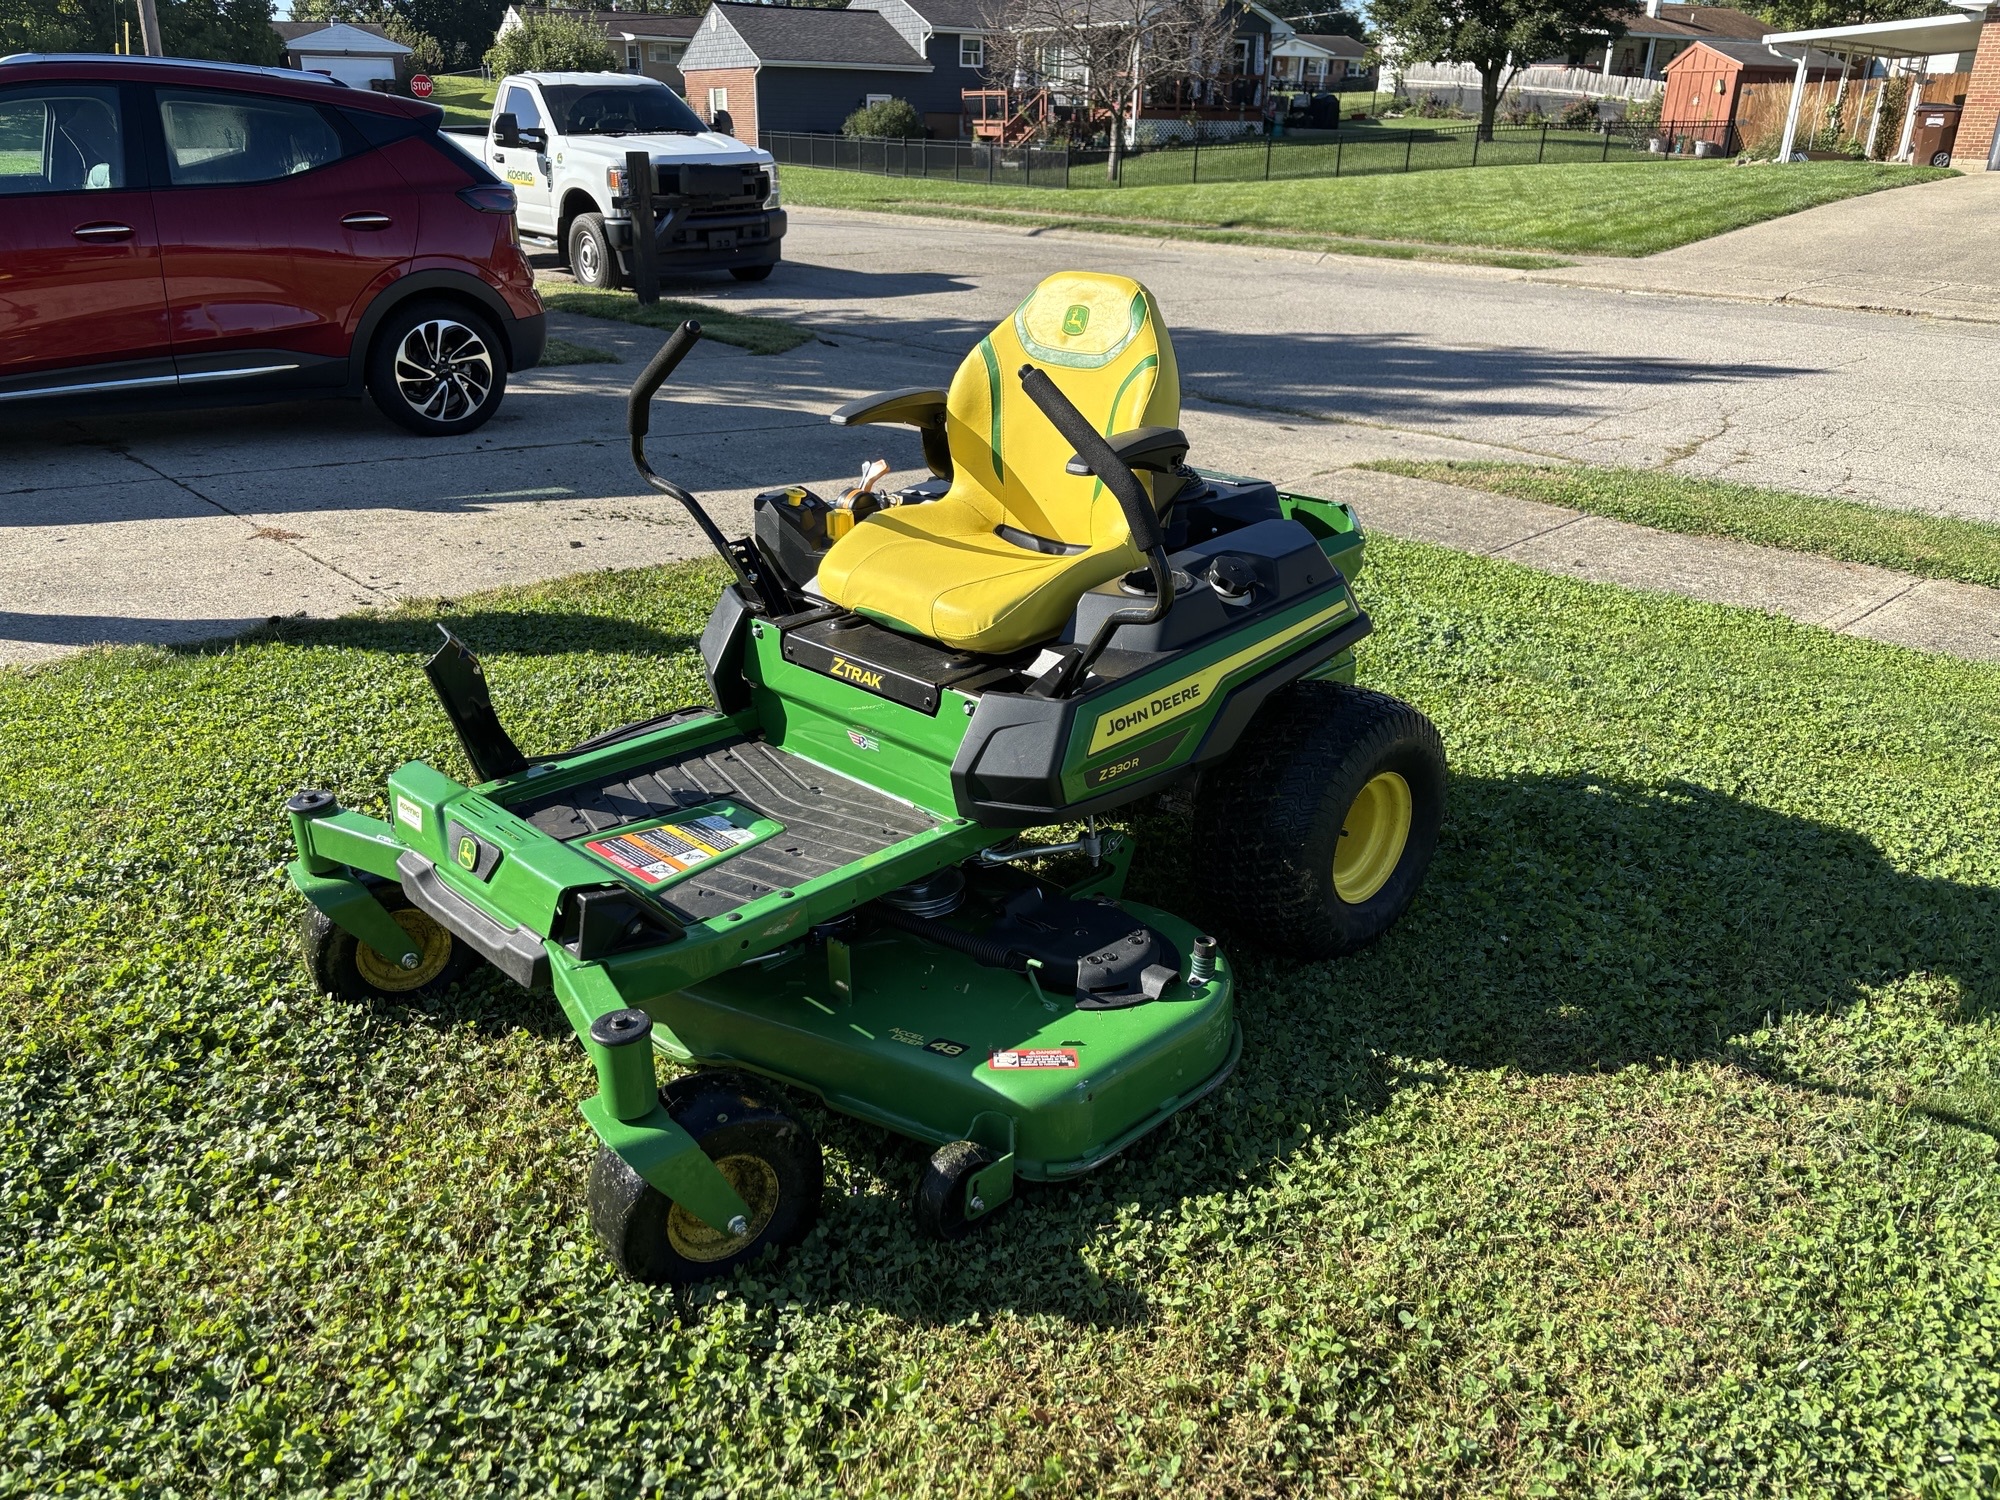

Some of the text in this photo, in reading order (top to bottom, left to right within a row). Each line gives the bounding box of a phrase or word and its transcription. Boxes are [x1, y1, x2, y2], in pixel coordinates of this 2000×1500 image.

[412, 81, 432, 91] STOP
[830, 657, 883, 690] ZTRAK
[1106, 683, 1201, 737] JOHN DEERE
[888, 1027, 925, 1041] ACCEL
[890, 1034, 924, 1047] DEEP
[929, 1042, 963, 1055] 48
